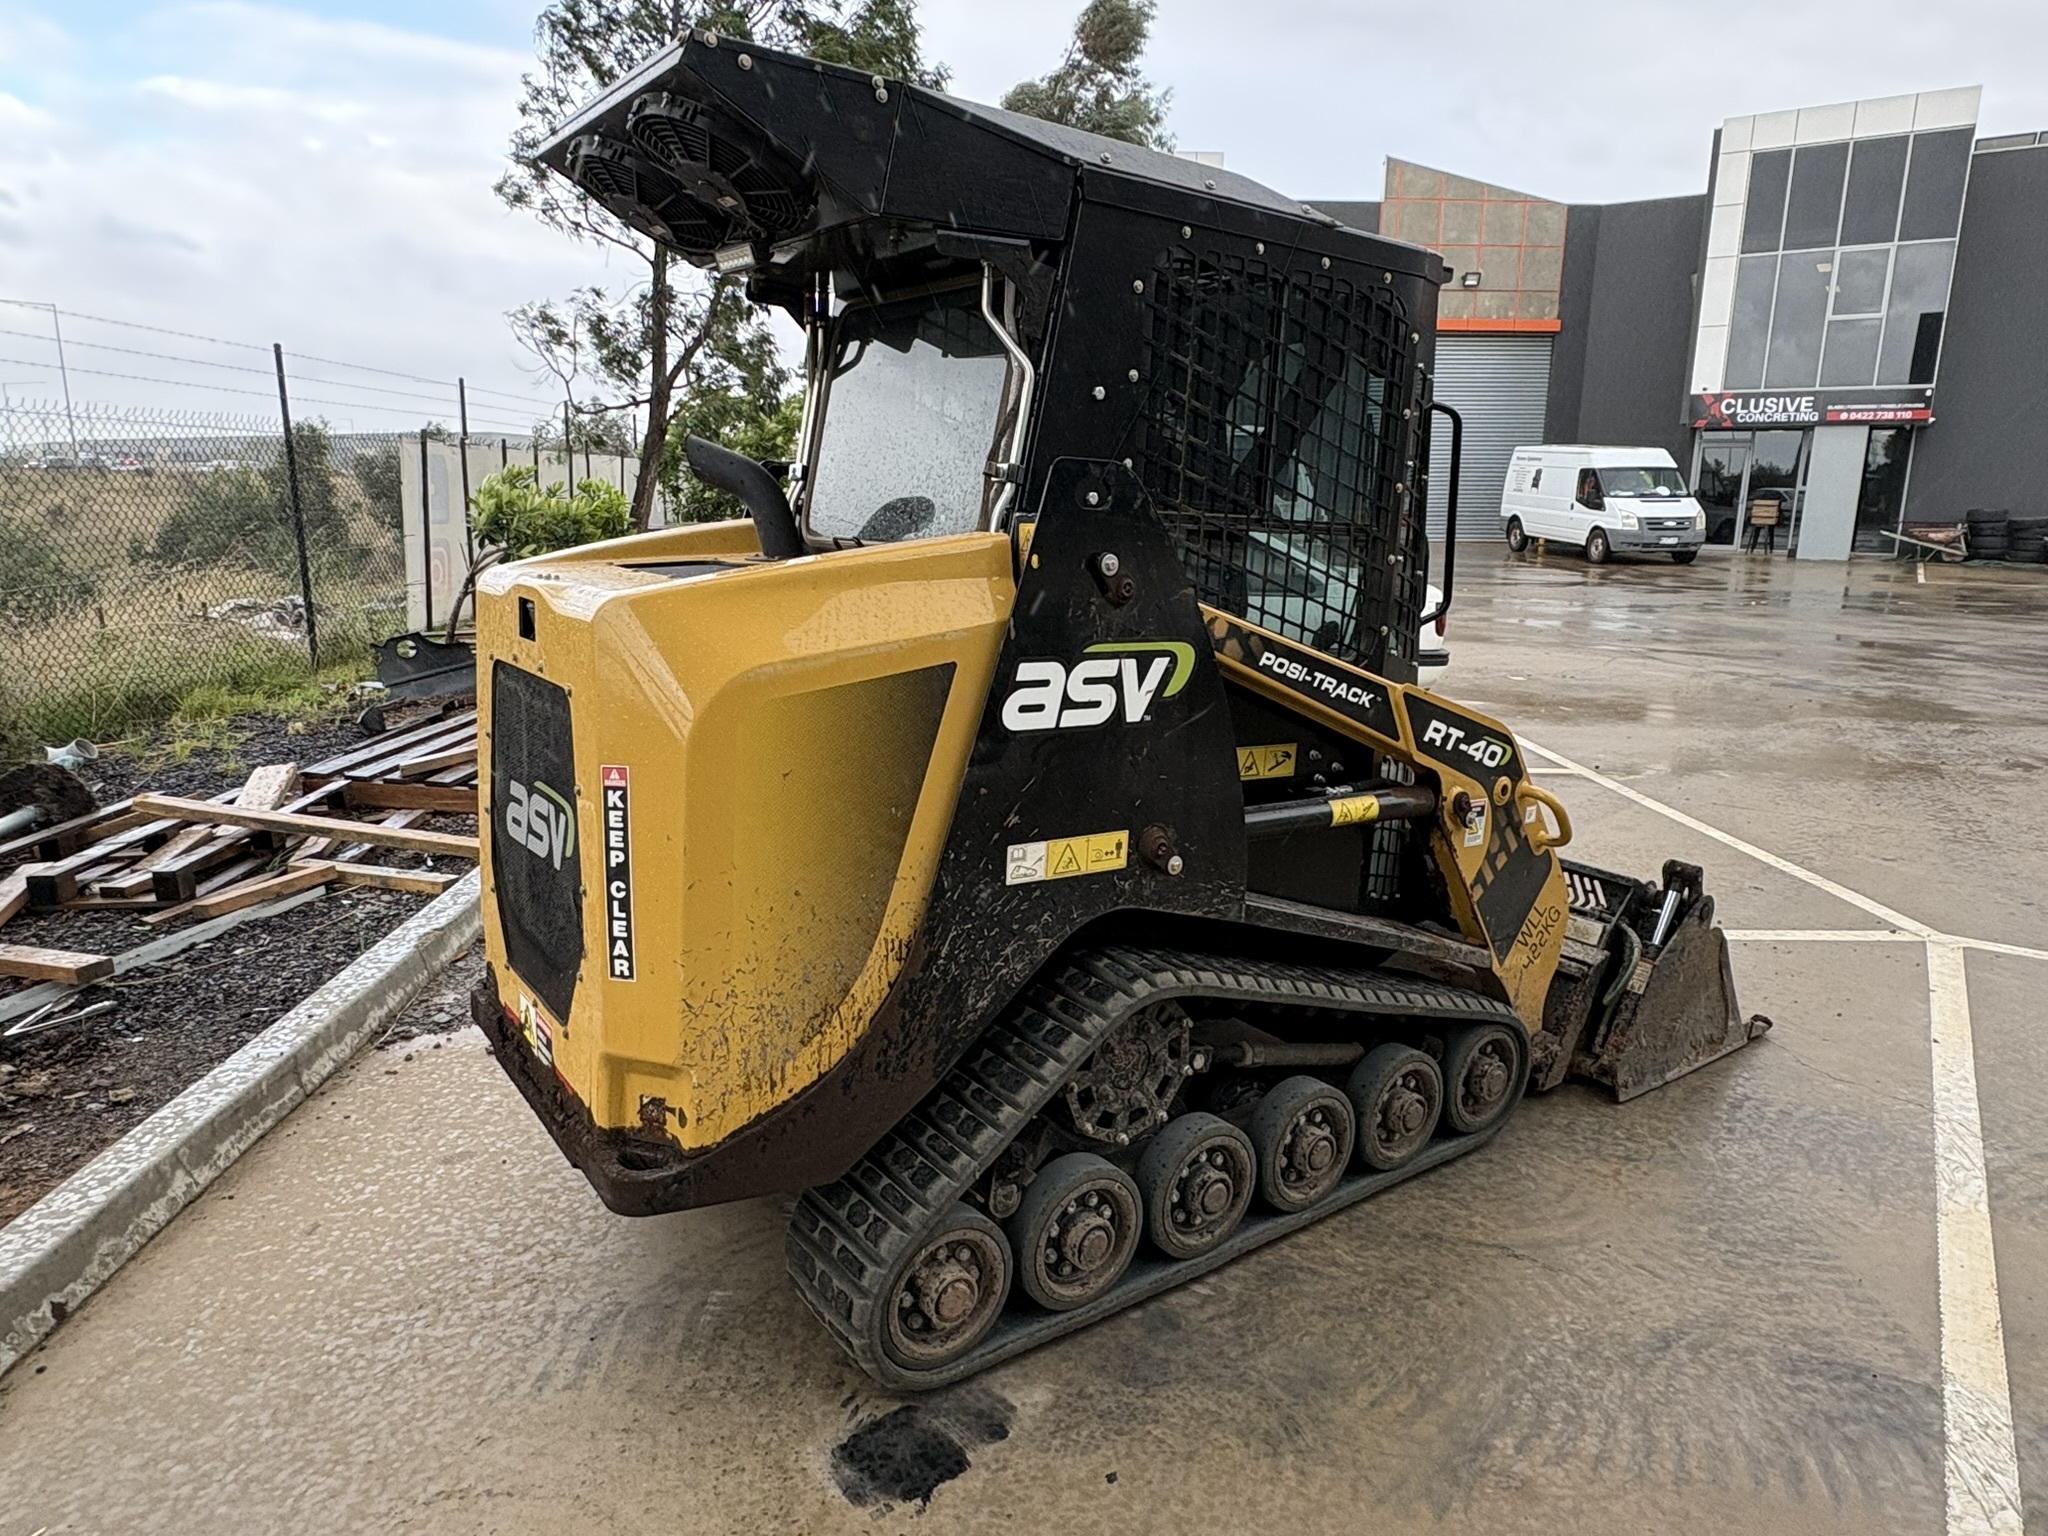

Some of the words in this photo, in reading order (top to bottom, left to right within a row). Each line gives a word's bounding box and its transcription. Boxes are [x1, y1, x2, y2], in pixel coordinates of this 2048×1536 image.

[1737, 411, 1820, 423] CONCRETING
[1849, 411, 1876, 420] 0422
[1258, 651, 1375, 708] POSI-TRACK
[1422, 719, 1503, 768] RT-40
[606, 790, 626, 868] KEEP
[610, 880, 630, 977] CLEAR
[1516, 905, 1549, 947] WLL
[1522, 904, 1562, 970] 422KG
